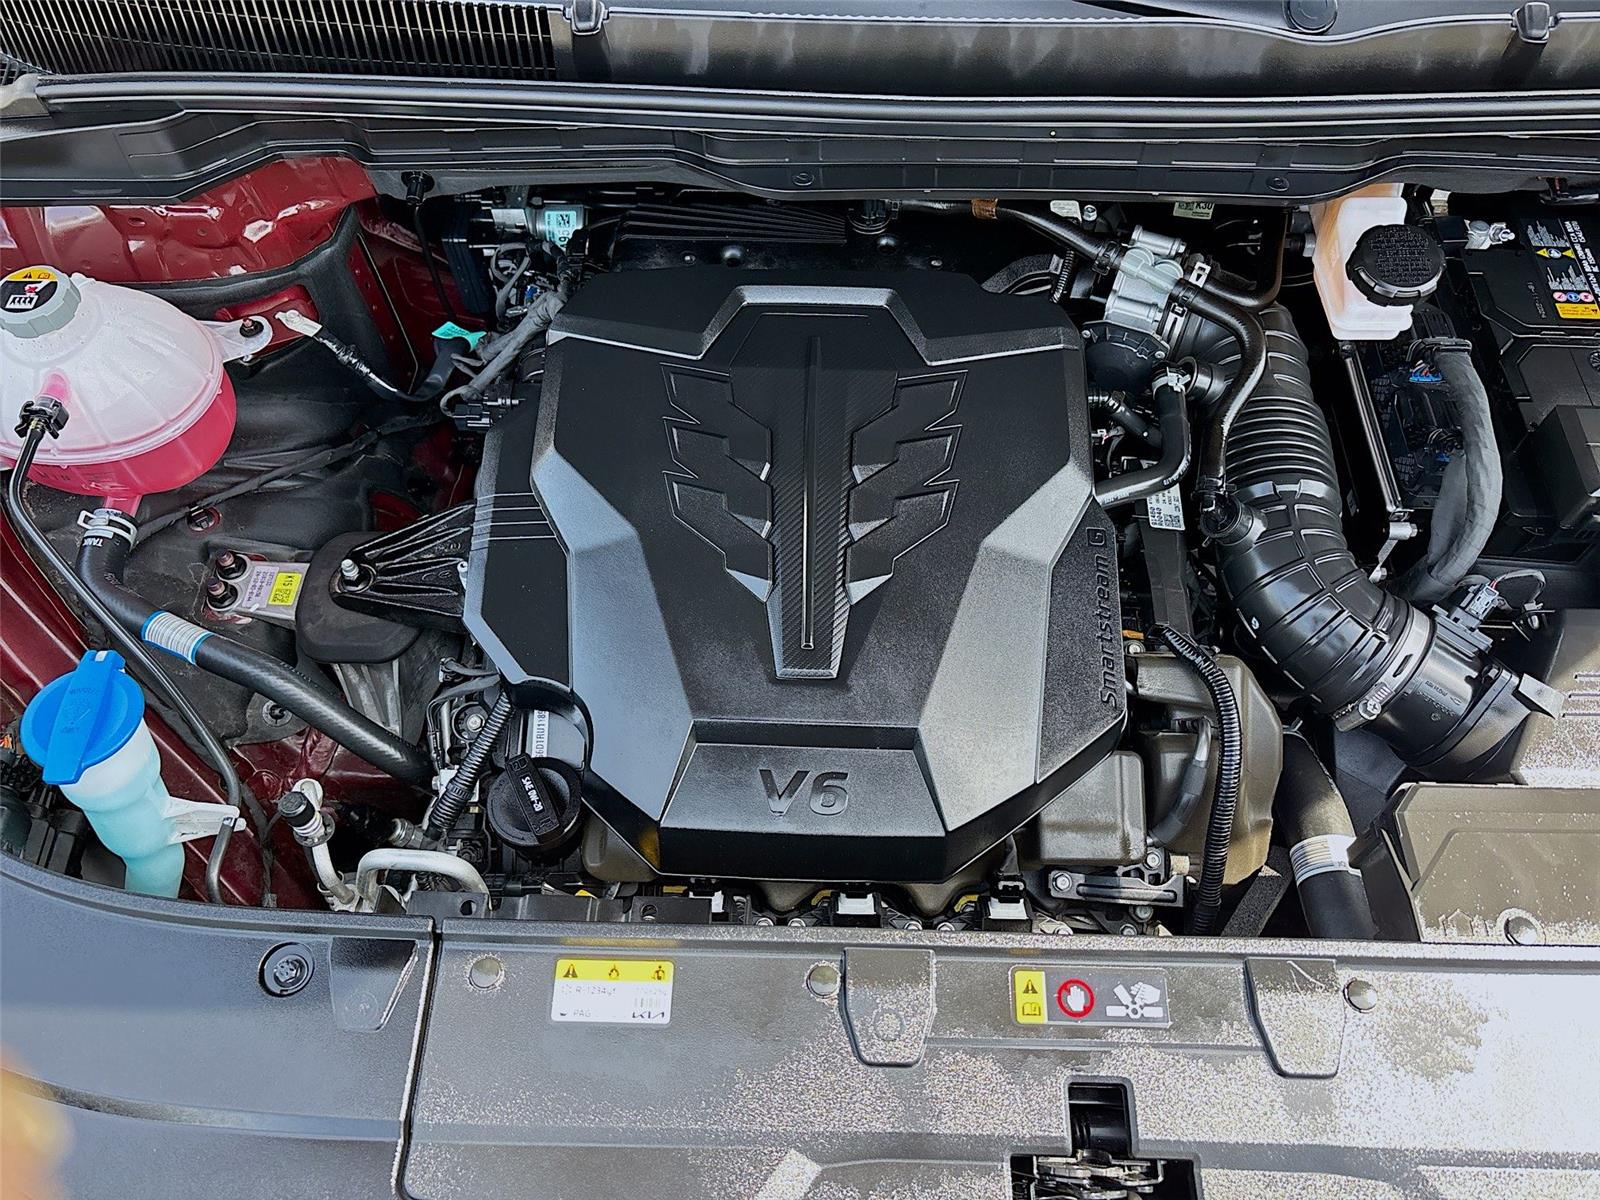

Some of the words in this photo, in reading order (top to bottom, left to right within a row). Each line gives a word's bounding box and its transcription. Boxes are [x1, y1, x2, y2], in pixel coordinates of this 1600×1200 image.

[82, 538, 103, 547] TANK
[282, 574, 296, 586] K15
[1095, 553, 1117, 708] Smartstream
[521, 776, 534, 791] SAE
[759, 769, 848, 815] V6
[527, 788, 544, 812] 0W-20
[632, 1011, 665, 1019] KIA
